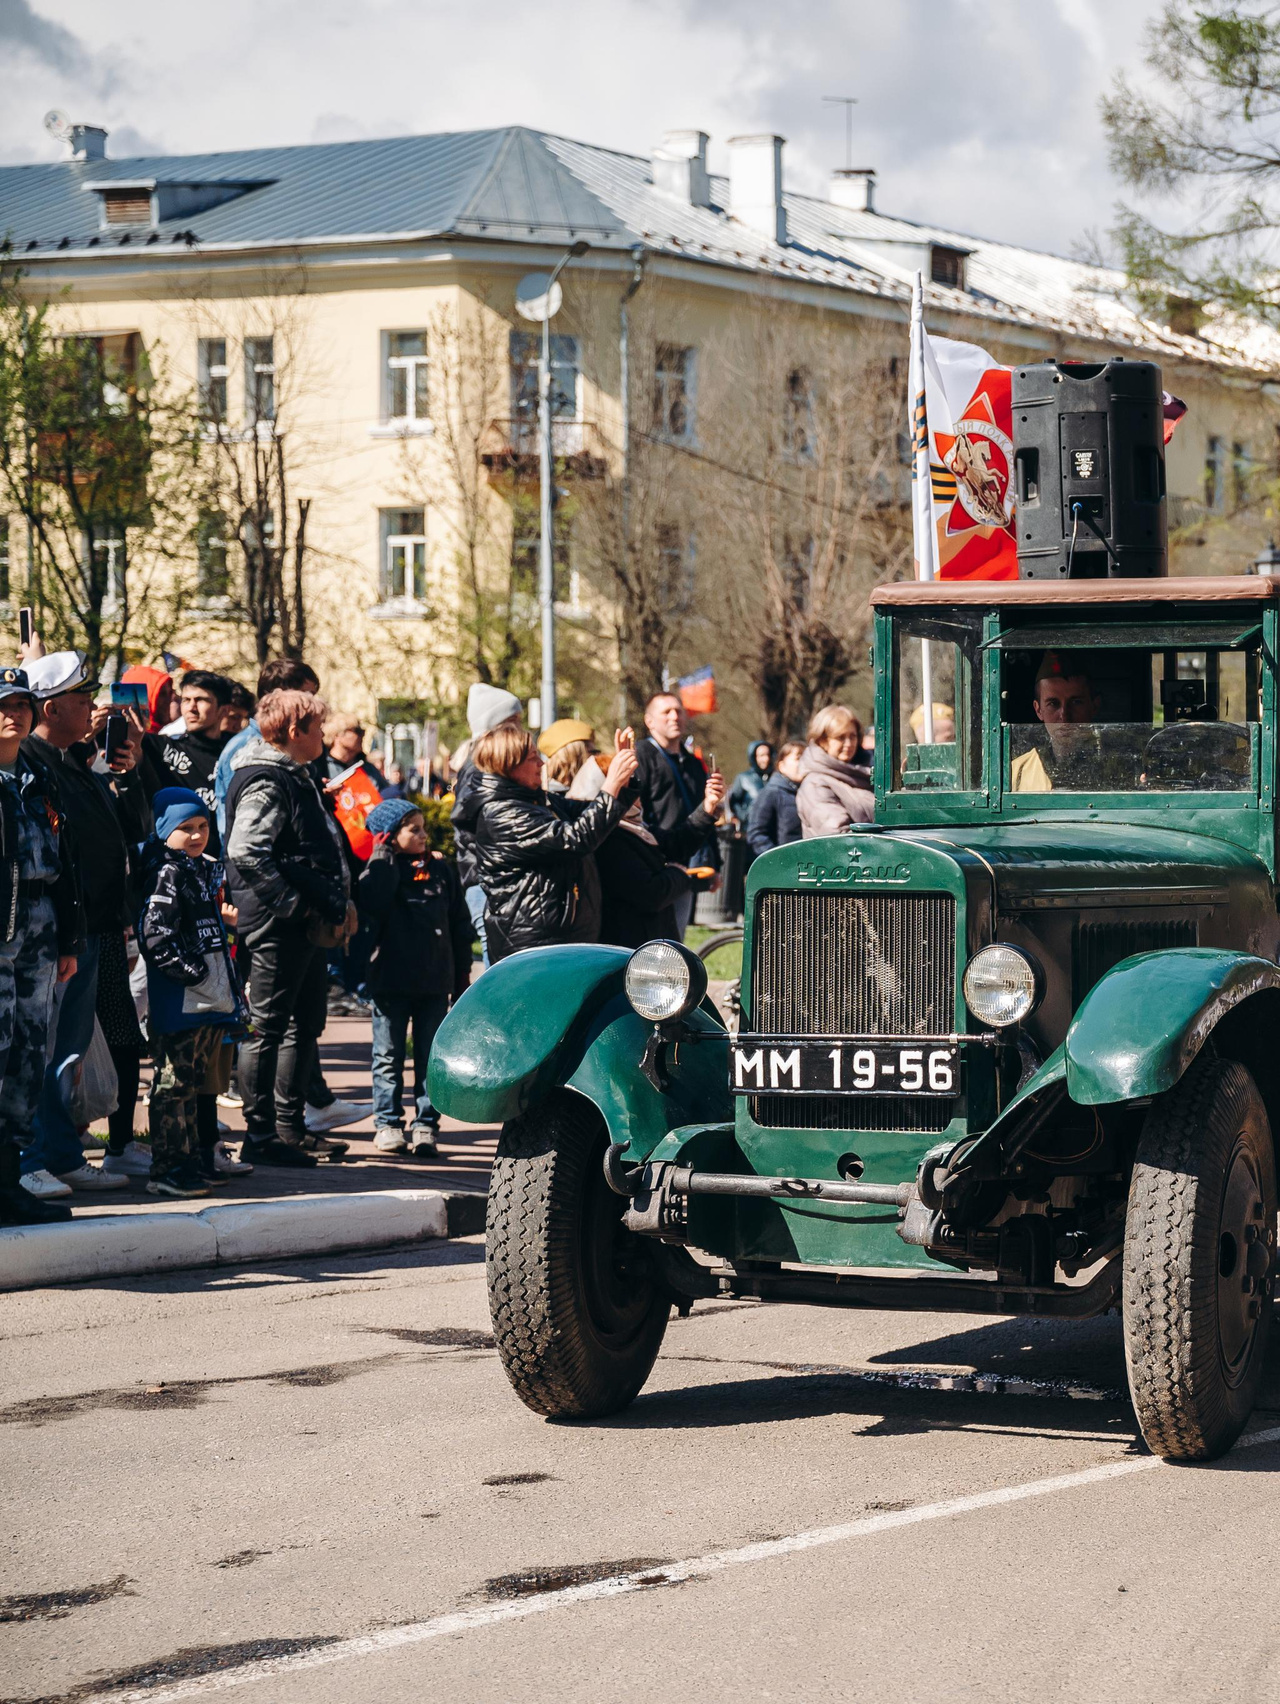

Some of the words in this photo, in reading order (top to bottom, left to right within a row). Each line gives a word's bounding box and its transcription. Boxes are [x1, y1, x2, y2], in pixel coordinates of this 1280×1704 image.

[978, 424, 1010, 449] ПОЛК
[733, 1048, 802, 1089] ММ
[828, 1048, 954, 1090] 19-56
